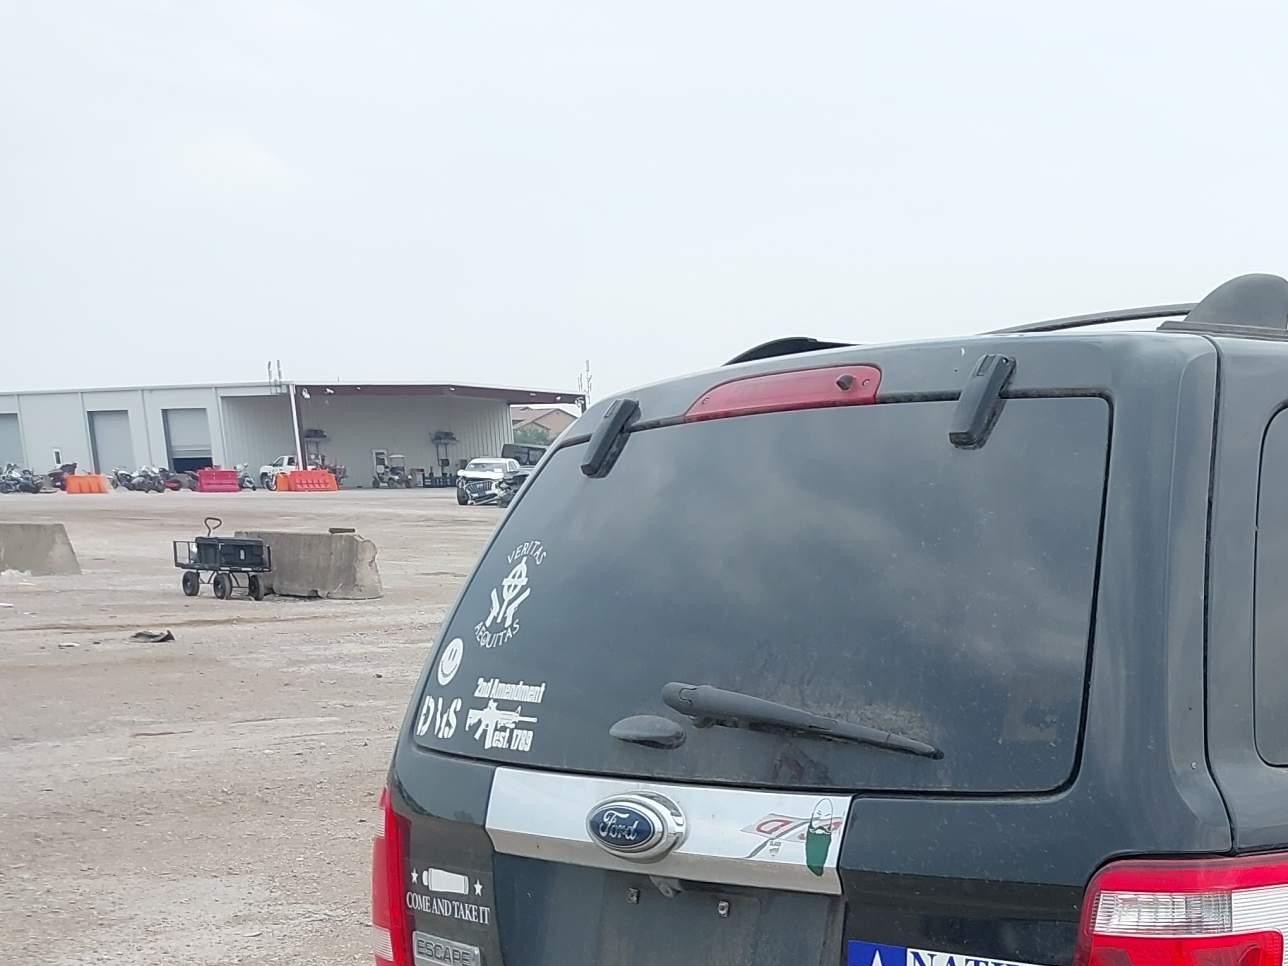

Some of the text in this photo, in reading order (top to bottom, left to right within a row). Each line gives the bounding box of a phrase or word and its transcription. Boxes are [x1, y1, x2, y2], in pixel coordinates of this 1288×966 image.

[506, 540, 548, 566] VERITAS
[474, 619, 520, 649] AEQUITAS
[473, 676, 547, 704] 2nd Amendment
[599, 809, 640, 841] Ford
[406, 891, 491, 925] COME AND TAKE IT
